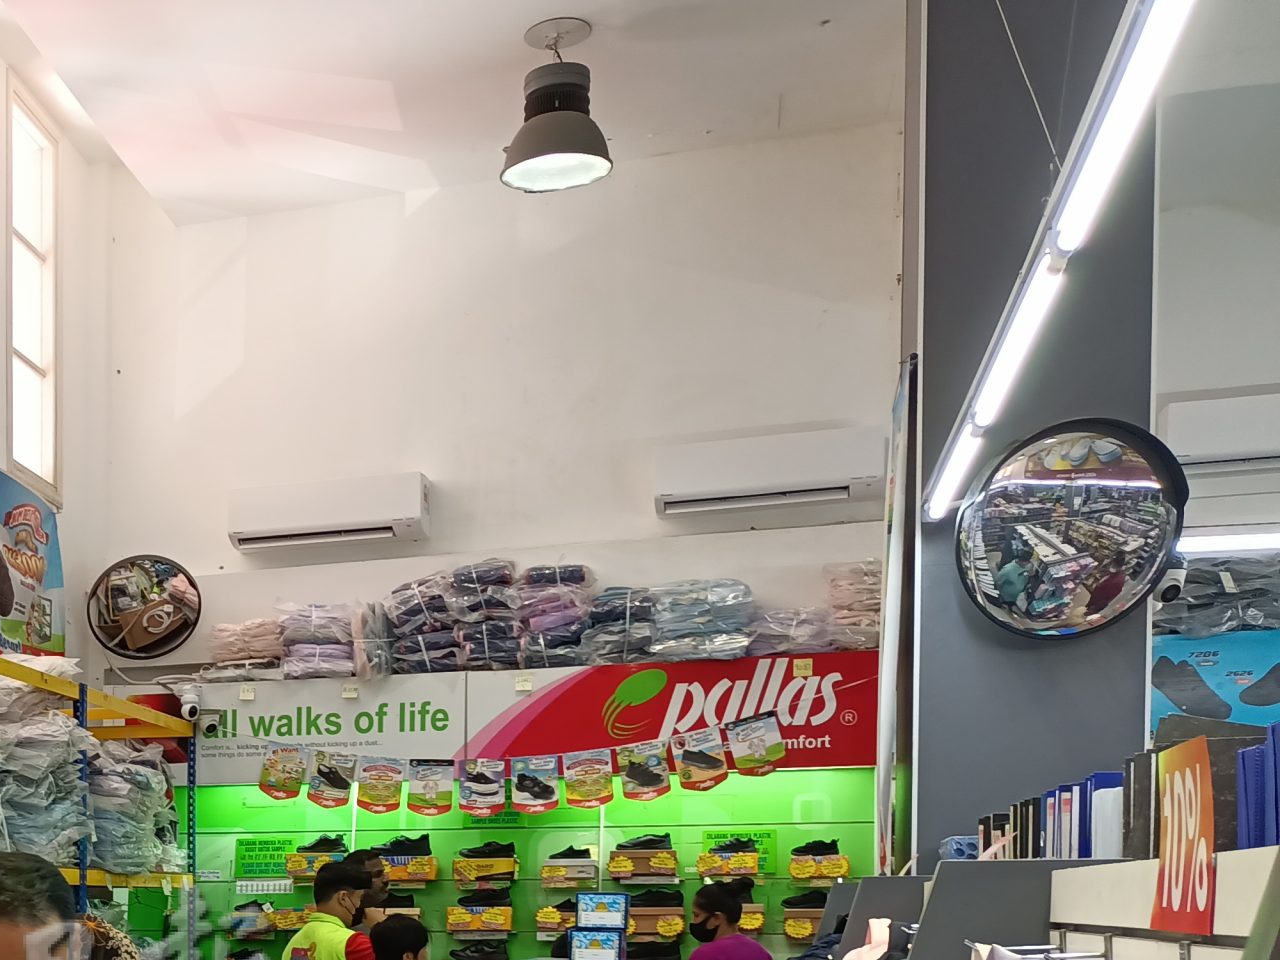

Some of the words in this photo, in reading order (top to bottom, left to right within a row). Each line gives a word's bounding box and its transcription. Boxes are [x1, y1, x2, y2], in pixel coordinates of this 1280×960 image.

[249, 706, 342, 737] walks
[354, 703, 388, 734] of
[399, 701, 449, 733] life
[658, 657, 843, 742] pallas
[784, 736, 831, 749] mfort
[1161, 763, 1208, 913] 10%
